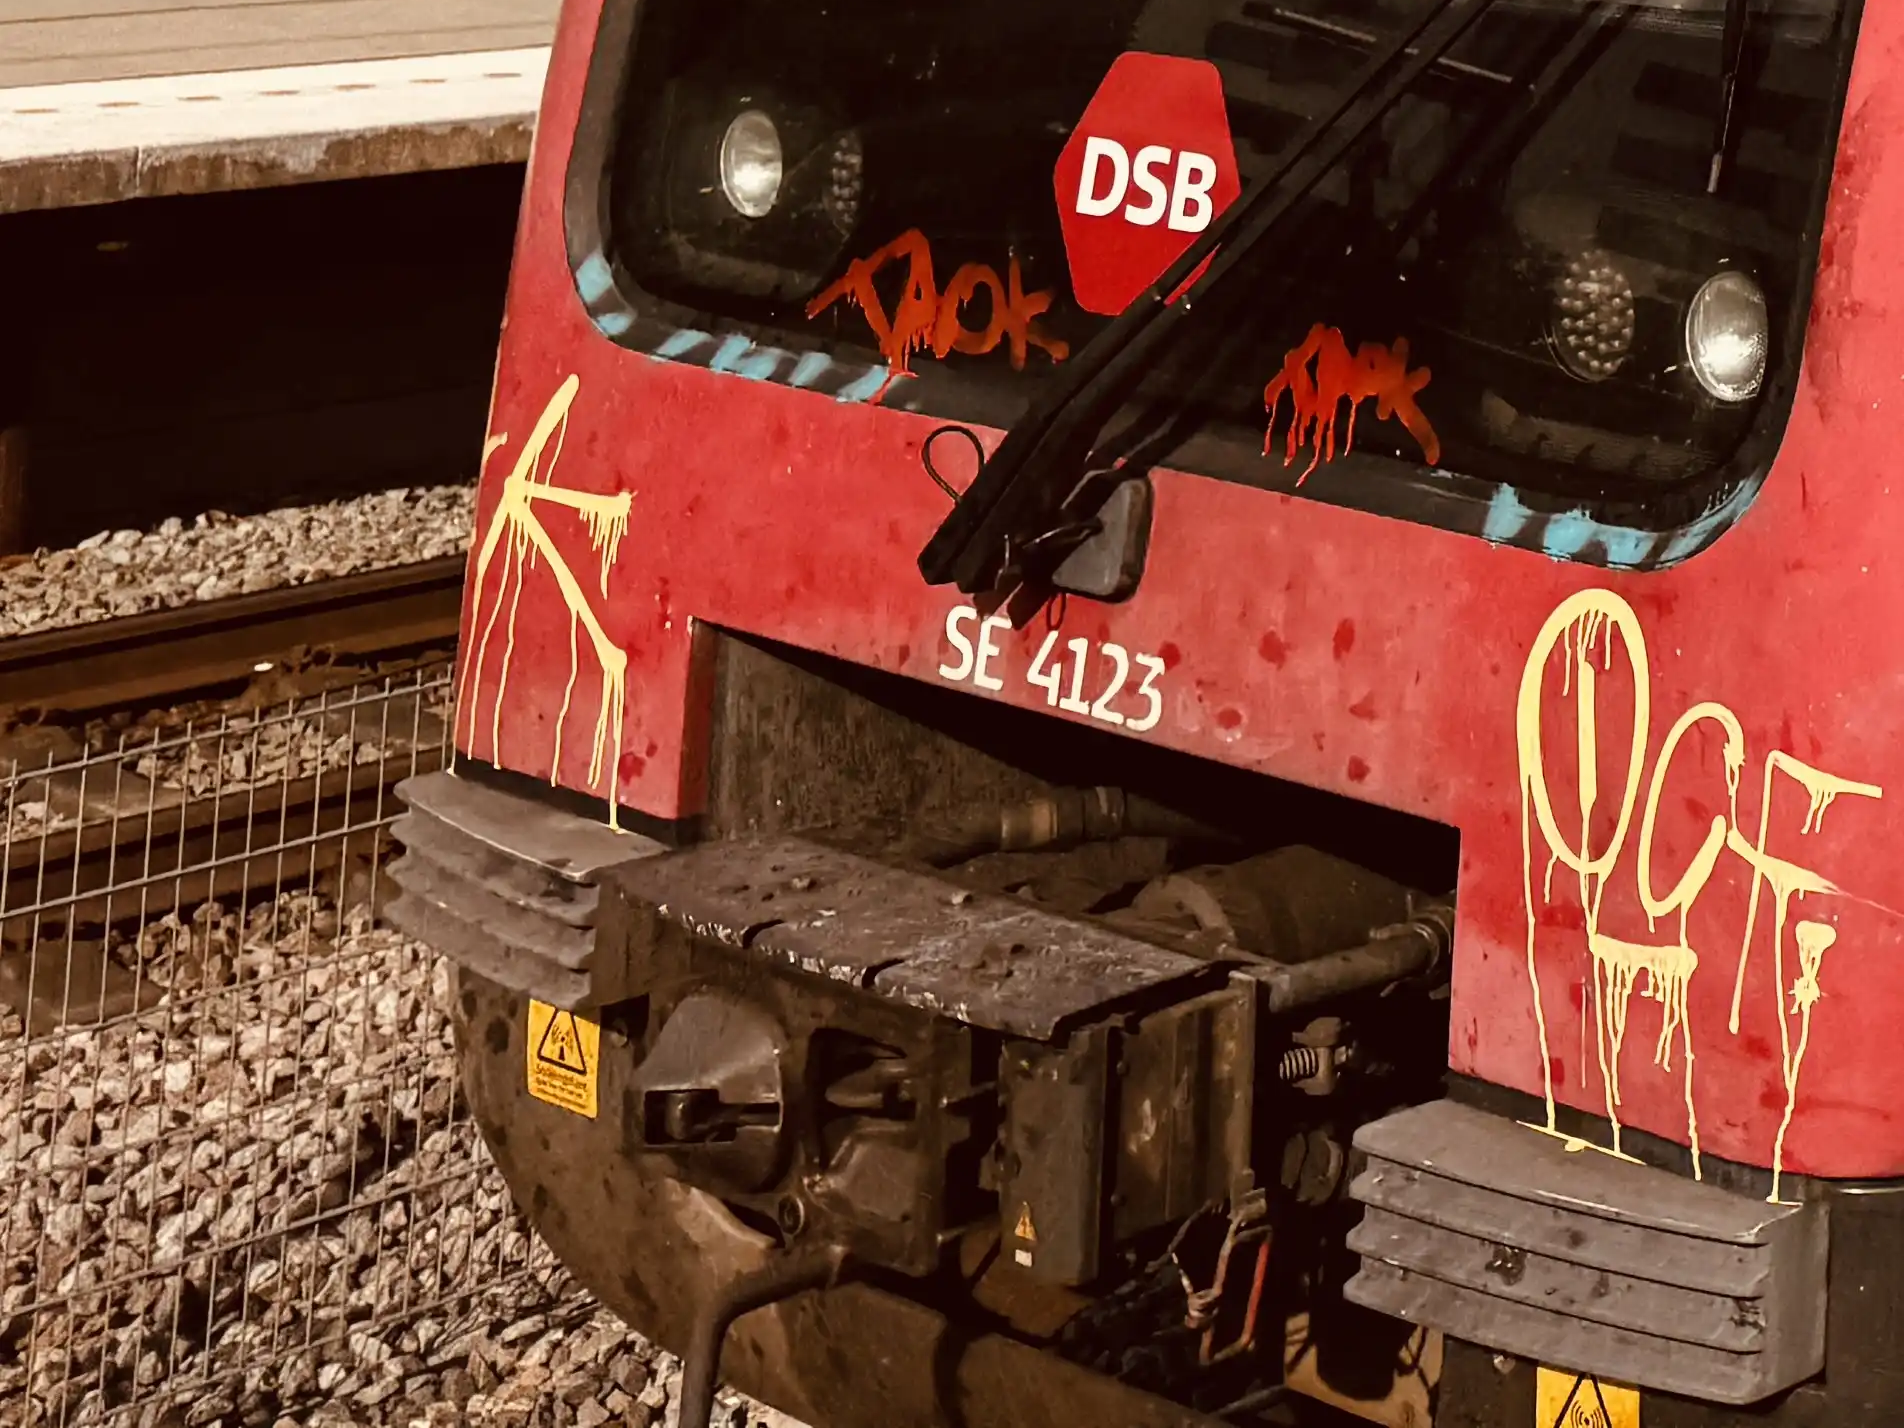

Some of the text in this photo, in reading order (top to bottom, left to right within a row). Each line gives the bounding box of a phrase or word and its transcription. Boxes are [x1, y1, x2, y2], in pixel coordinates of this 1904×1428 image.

[1075, 135, 1217, 233] DSB
[939, 605, 1165, 732] SE 4123
